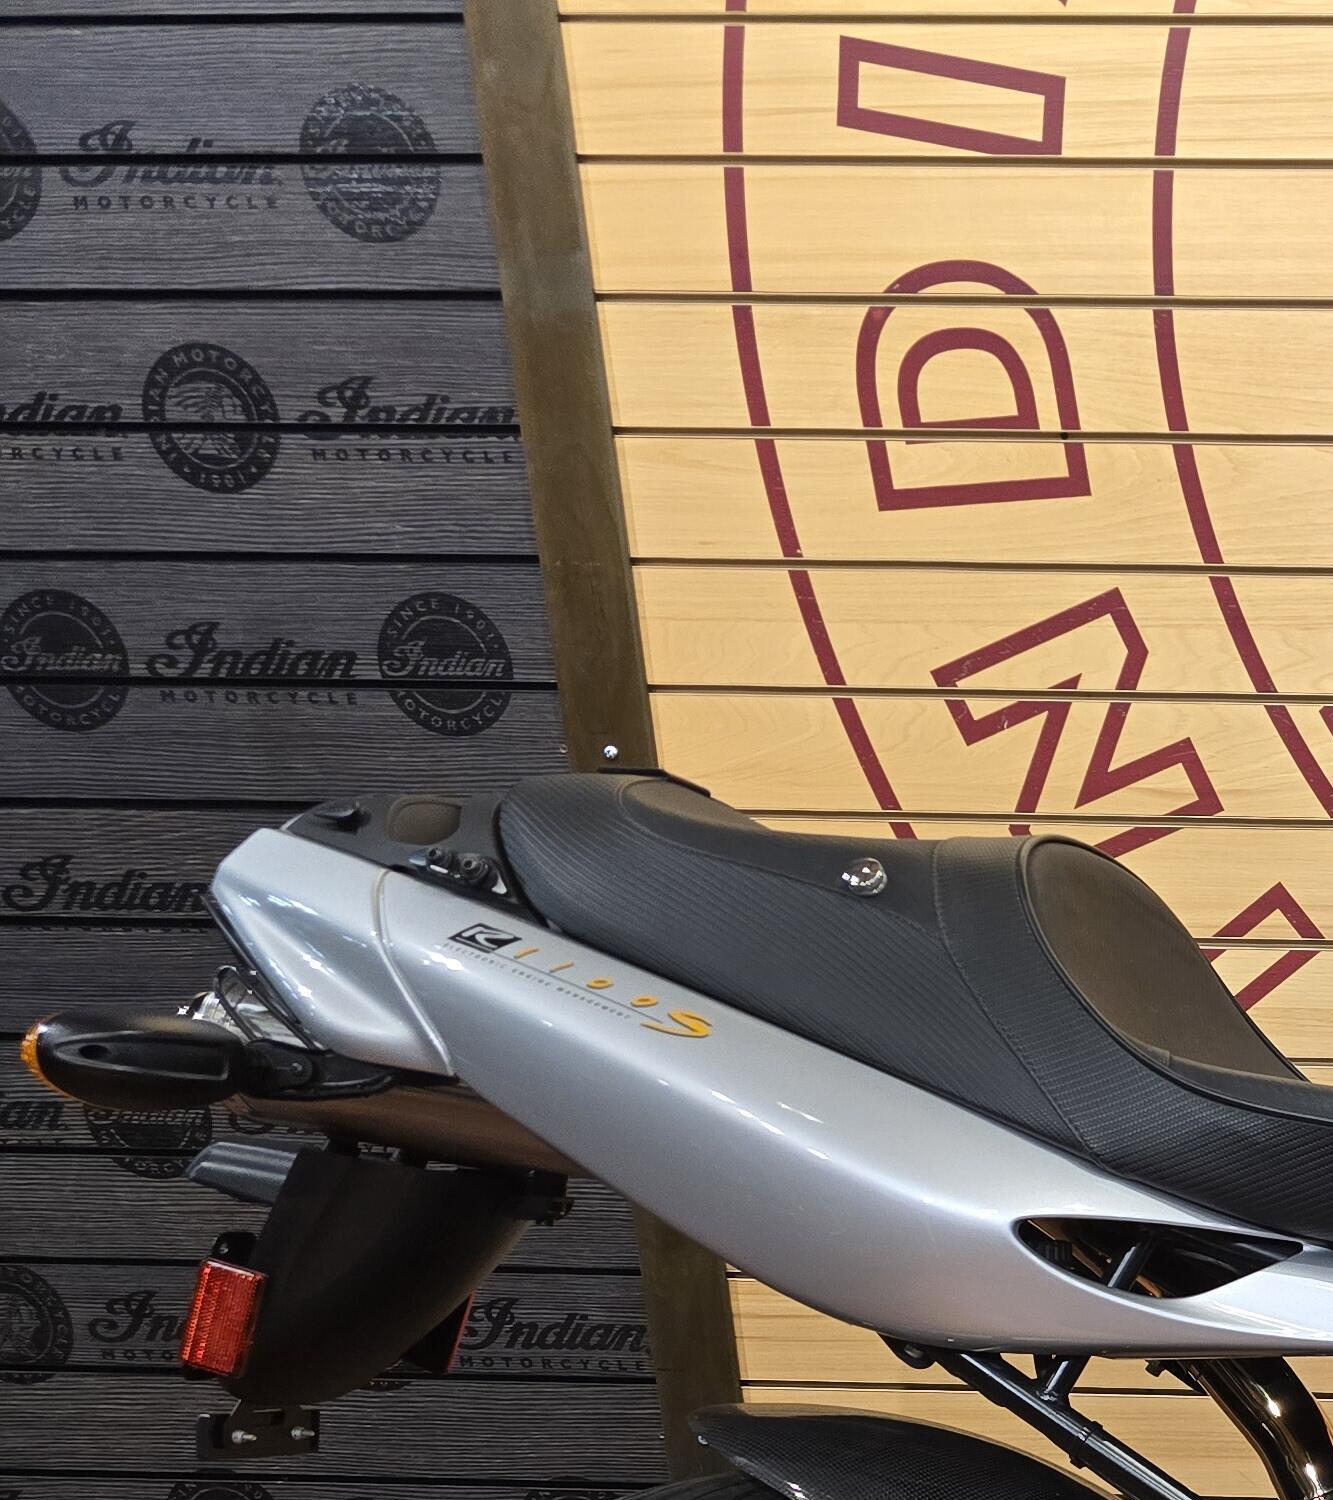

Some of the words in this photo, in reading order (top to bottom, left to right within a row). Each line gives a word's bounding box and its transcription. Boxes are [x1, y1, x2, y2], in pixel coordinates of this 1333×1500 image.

[57, 119, 283, 187] Indian
[73, 196, 279, 210] MOTORCYCLE
[0, 391, 128, 438] dian
[298, 376, 523, 441] Indian
[10, 446, 123, 461] RCYCLE
[311, 449, 514, 465] MOTORCYCLE
[147, 621, 358, 683] Indian
[382, 639, 506, 677] Indian
[159, 689, 357, 706] MOTORCYCLE
[459, 1297, 650, 1353] Indian
[459, 1356, 649, 1371] MOTORCYCLE
